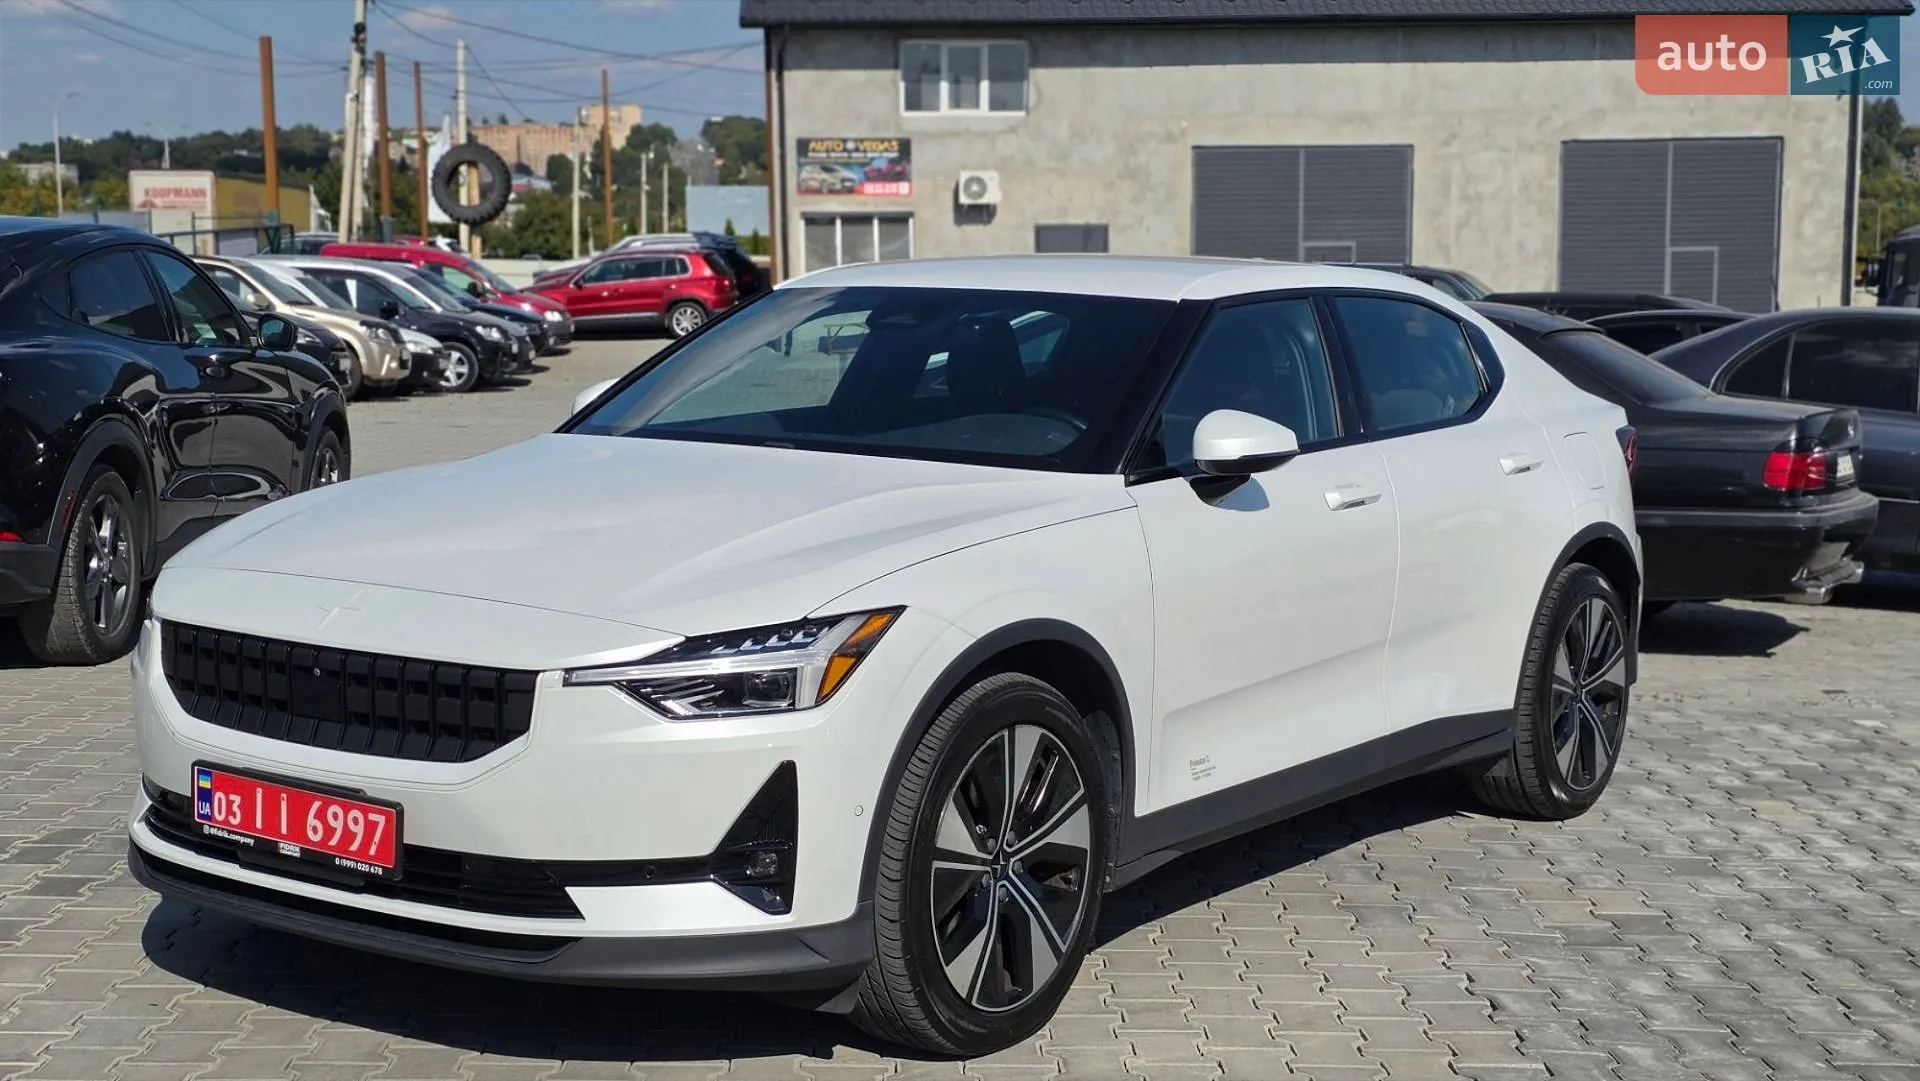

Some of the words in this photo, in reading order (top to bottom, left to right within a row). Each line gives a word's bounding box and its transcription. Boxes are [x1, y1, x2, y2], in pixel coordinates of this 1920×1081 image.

[809, 140, 844, 152] AUTO
[858, 140, 899, 152] VEGAS
[144, 188, 207, 199] KOOPMANN
[199, 800, 212, 816] UA
[214, 791, 241, 825] 03
[306, 801, 386, 856] 6997
